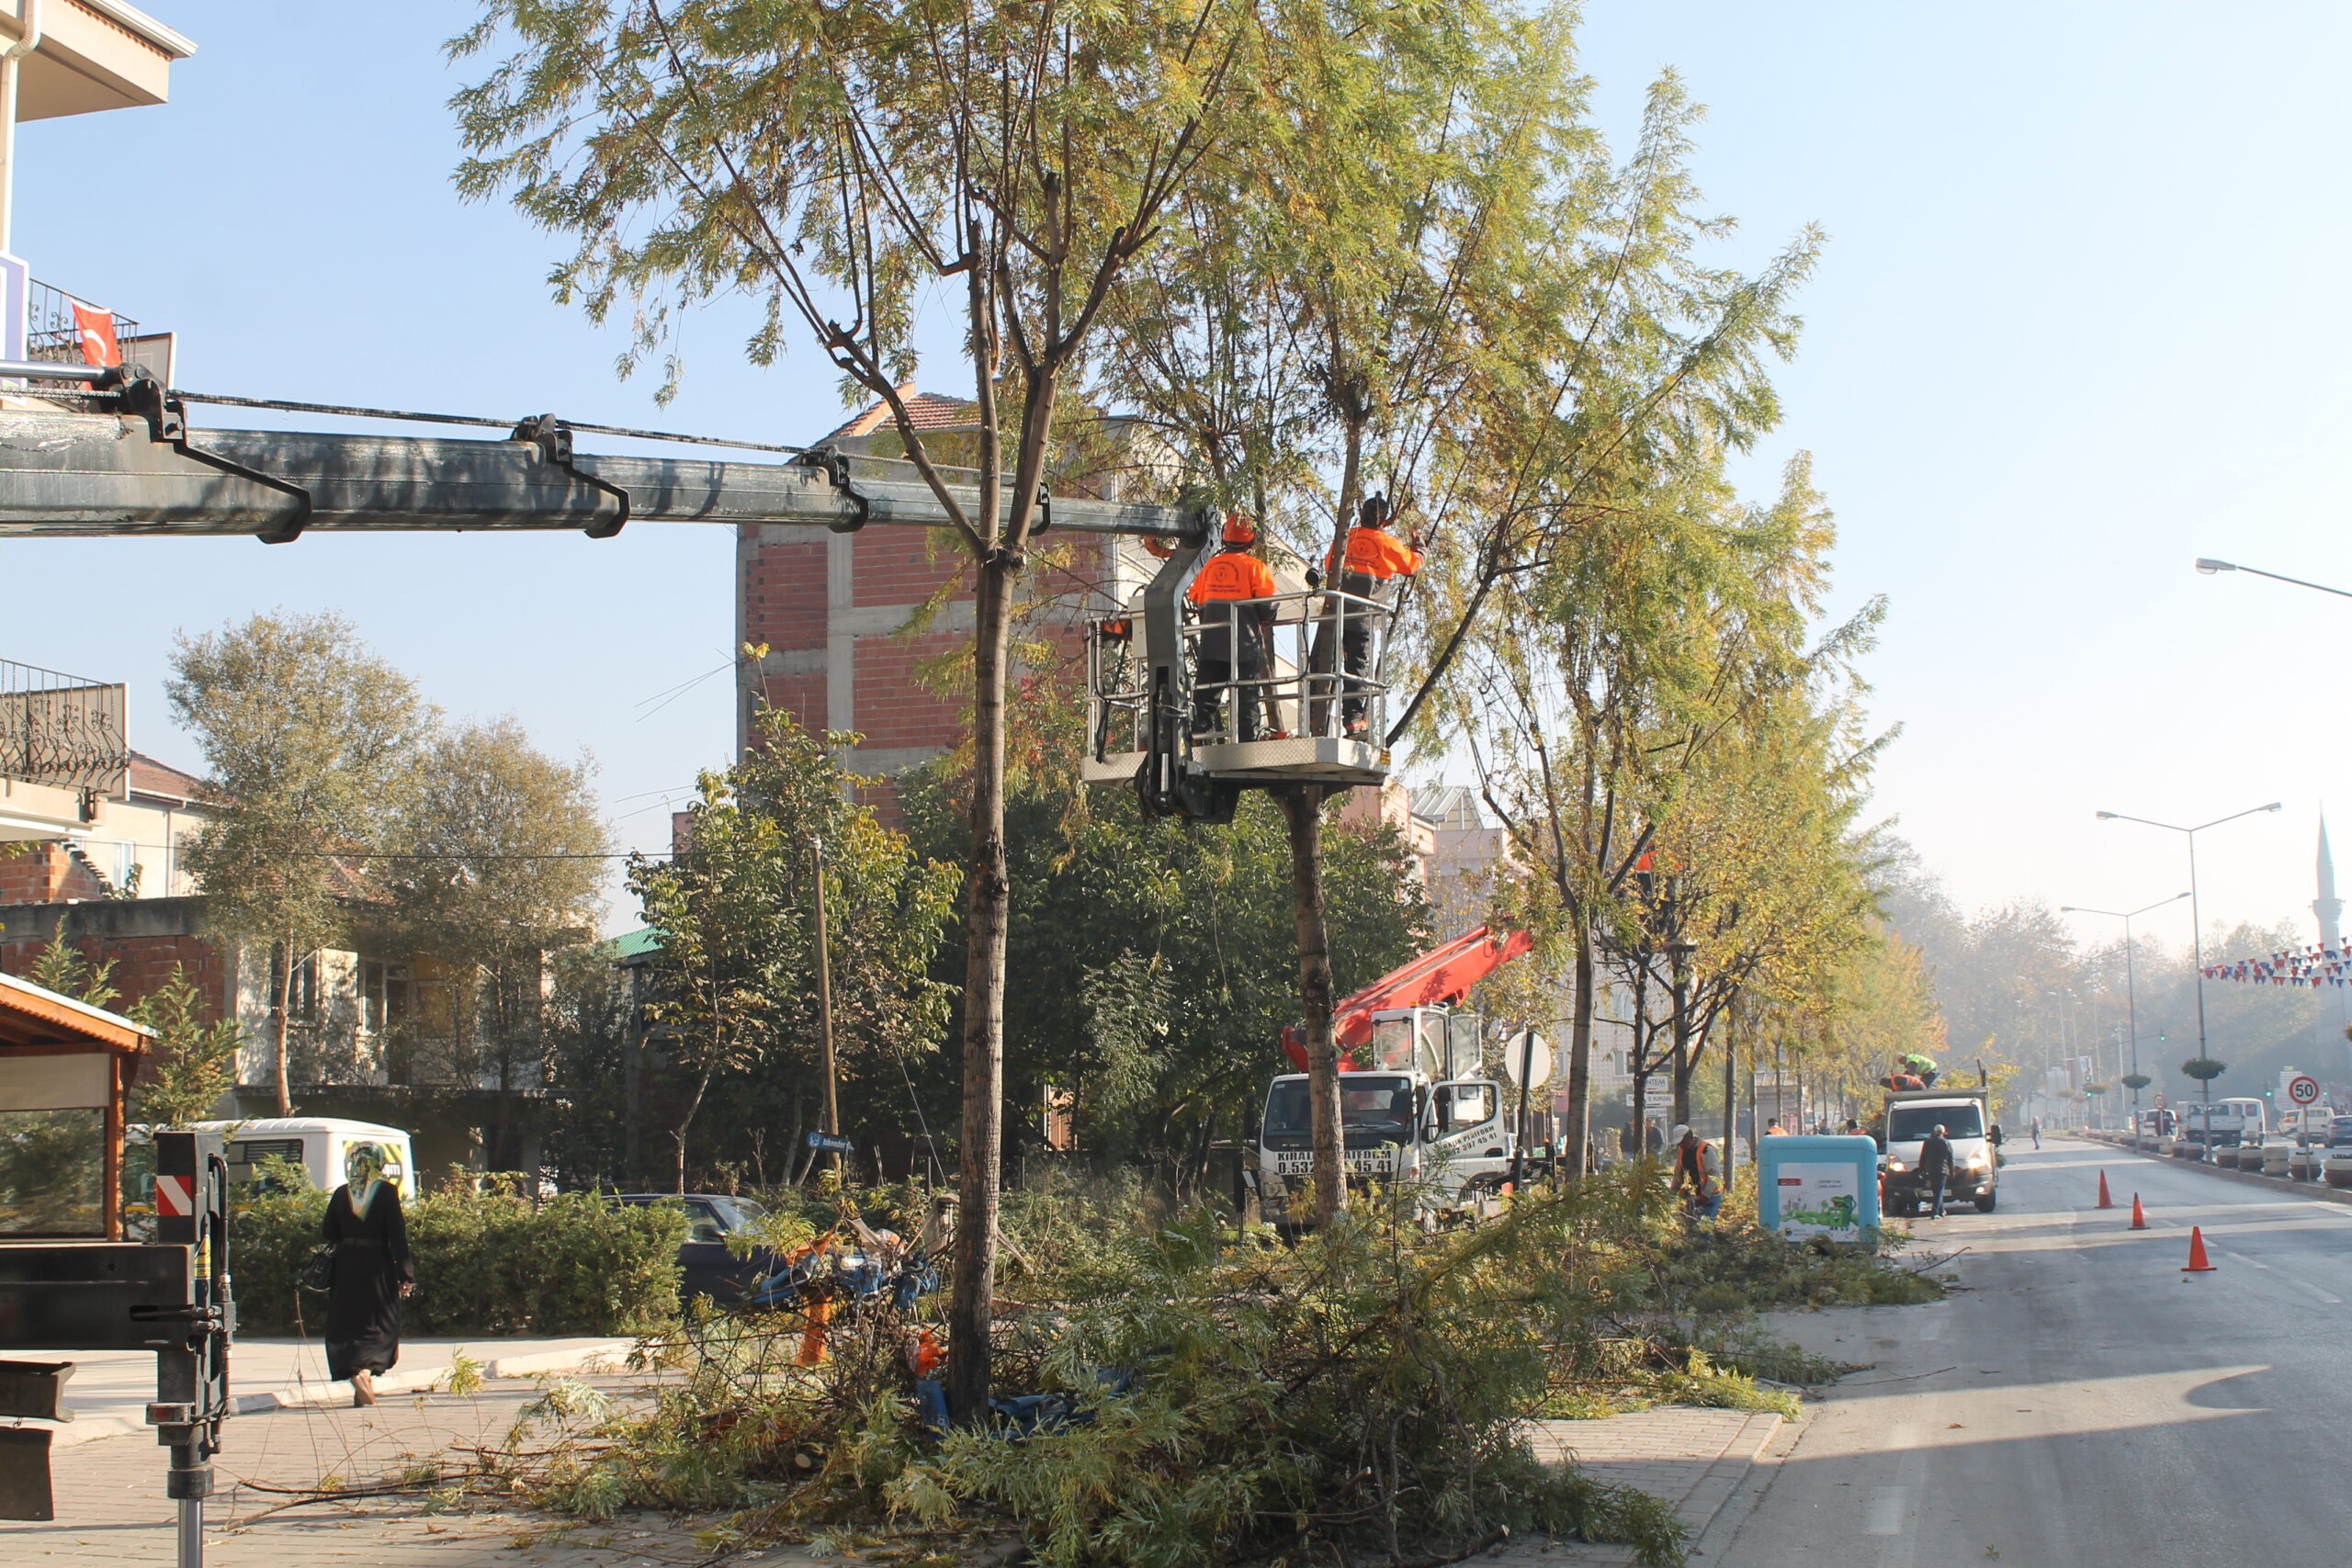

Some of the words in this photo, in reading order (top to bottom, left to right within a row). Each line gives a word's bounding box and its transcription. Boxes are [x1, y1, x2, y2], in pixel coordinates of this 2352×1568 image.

[2295, 1084, 2313, 1097] 50
[1443, 1138, 1462, 1149] RALIK
[1463, 1125, 1495, 1142] PLATFORM
[1343, 1150, 1391, 1160] ATFORM
[1354, 1160, 1372, 1172] 45
[1376, 1160, 1392, 1172] 41
